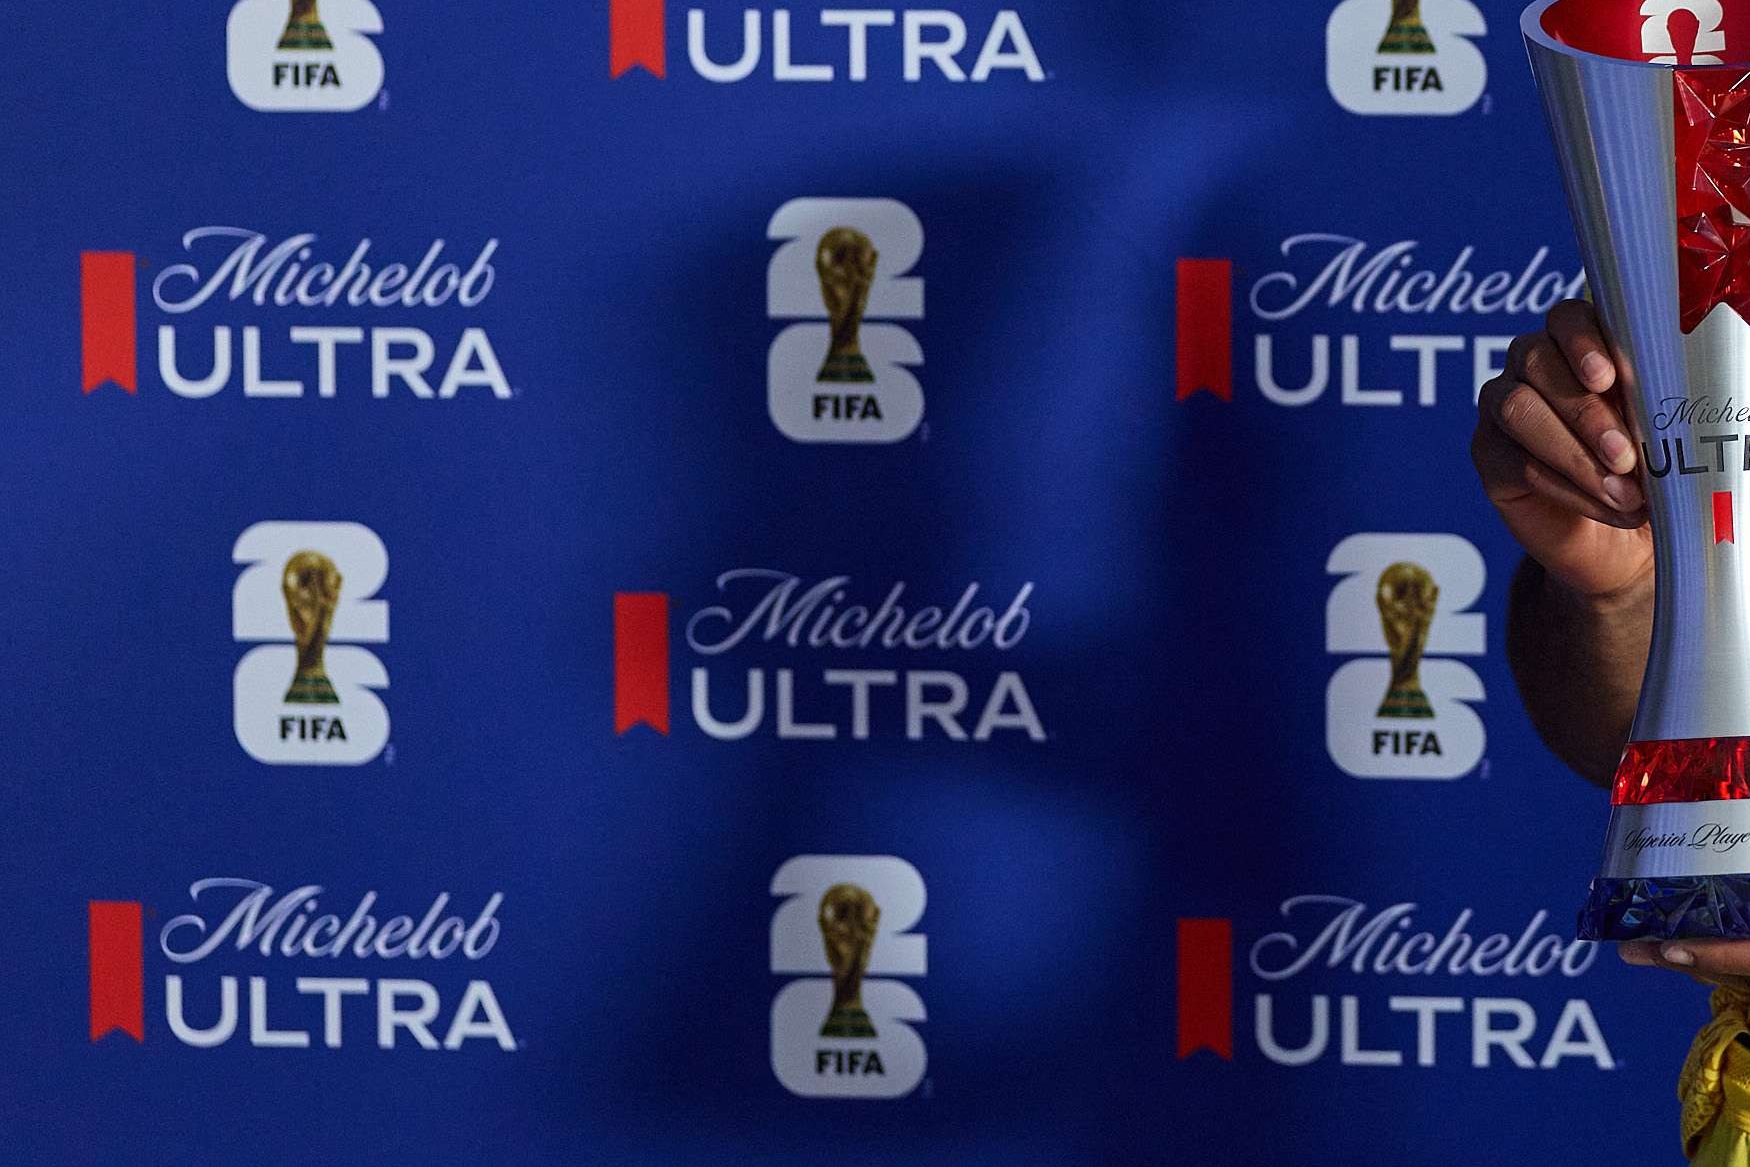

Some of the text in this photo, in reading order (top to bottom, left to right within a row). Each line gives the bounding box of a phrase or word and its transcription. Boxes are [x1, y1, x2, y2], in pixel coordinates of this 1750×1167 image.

[273, 62, 341, 88] FIFA
[688, 9, 1047, 84] ULTRA
[1372, 66, 1444, 92] FIFA
[153, 227, 500, 315] Michelob
[158, 325, 514, 401] ULTRA
[1256, 335, 1518, 408] ULT
[812, 394, 884, 421] FIFA
[688, 569, 1036, 656] Michelob
[279, 716, 348, 742] FIFA
[692, 667, 1048, 742] ULTRA
[1371, 729, 1443, 757] FIFA
[1624, 826, 1687, 857] Superior
[160, 878, 505, 964] Michelob
[166, 975, 518, 1052] ULTRA
[1256, 995, 1617, 1072] ULTRA
[814, 1048, 886, 1077] FIFA
